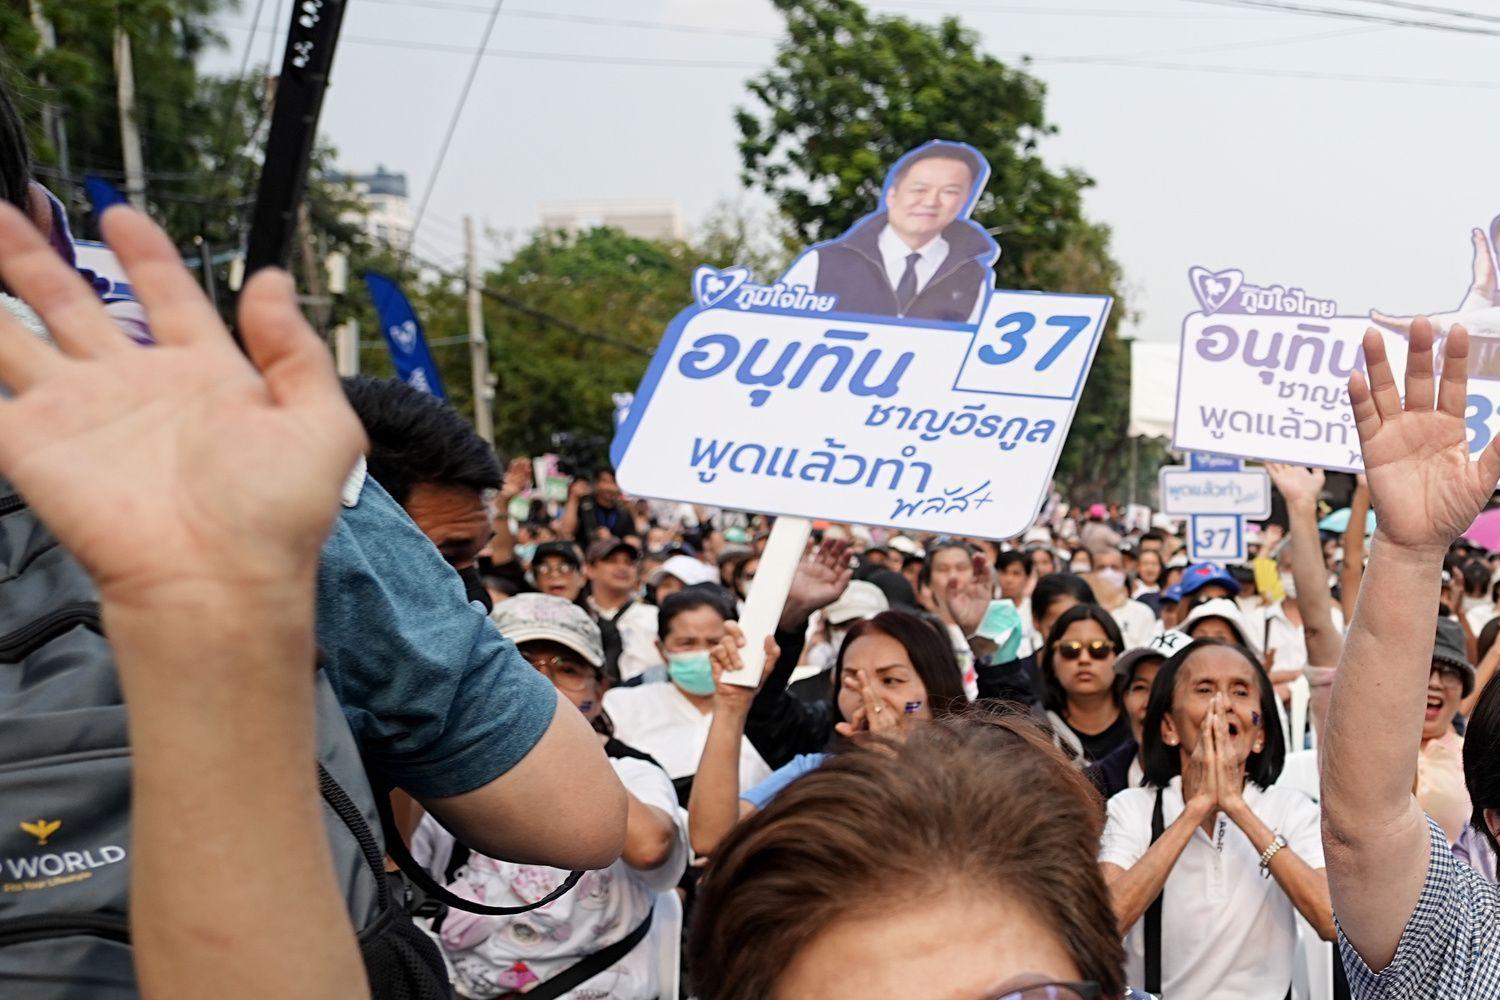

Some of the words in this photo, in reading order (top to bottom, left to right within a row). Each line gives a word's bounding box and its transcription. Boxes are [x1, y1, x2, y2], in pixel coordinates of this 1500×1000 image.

[735, 283, 836, 312] ภูมิใจไทย
[1240, 284, 1336, 319] ภูมิใจไทย
[977, 311, 1092, 372] 37
[1195, 323, 1366, 386] อนุทิน
[678, 329, 915, 408] อนุทิน
[864, 403, 1056, 451] ชาญวีรกูล
[689, 436, 933, 494] พูดแล้วทำ
[1196, 528, 1232, 550] 37
[6, 845, 126, 879] WORLD
